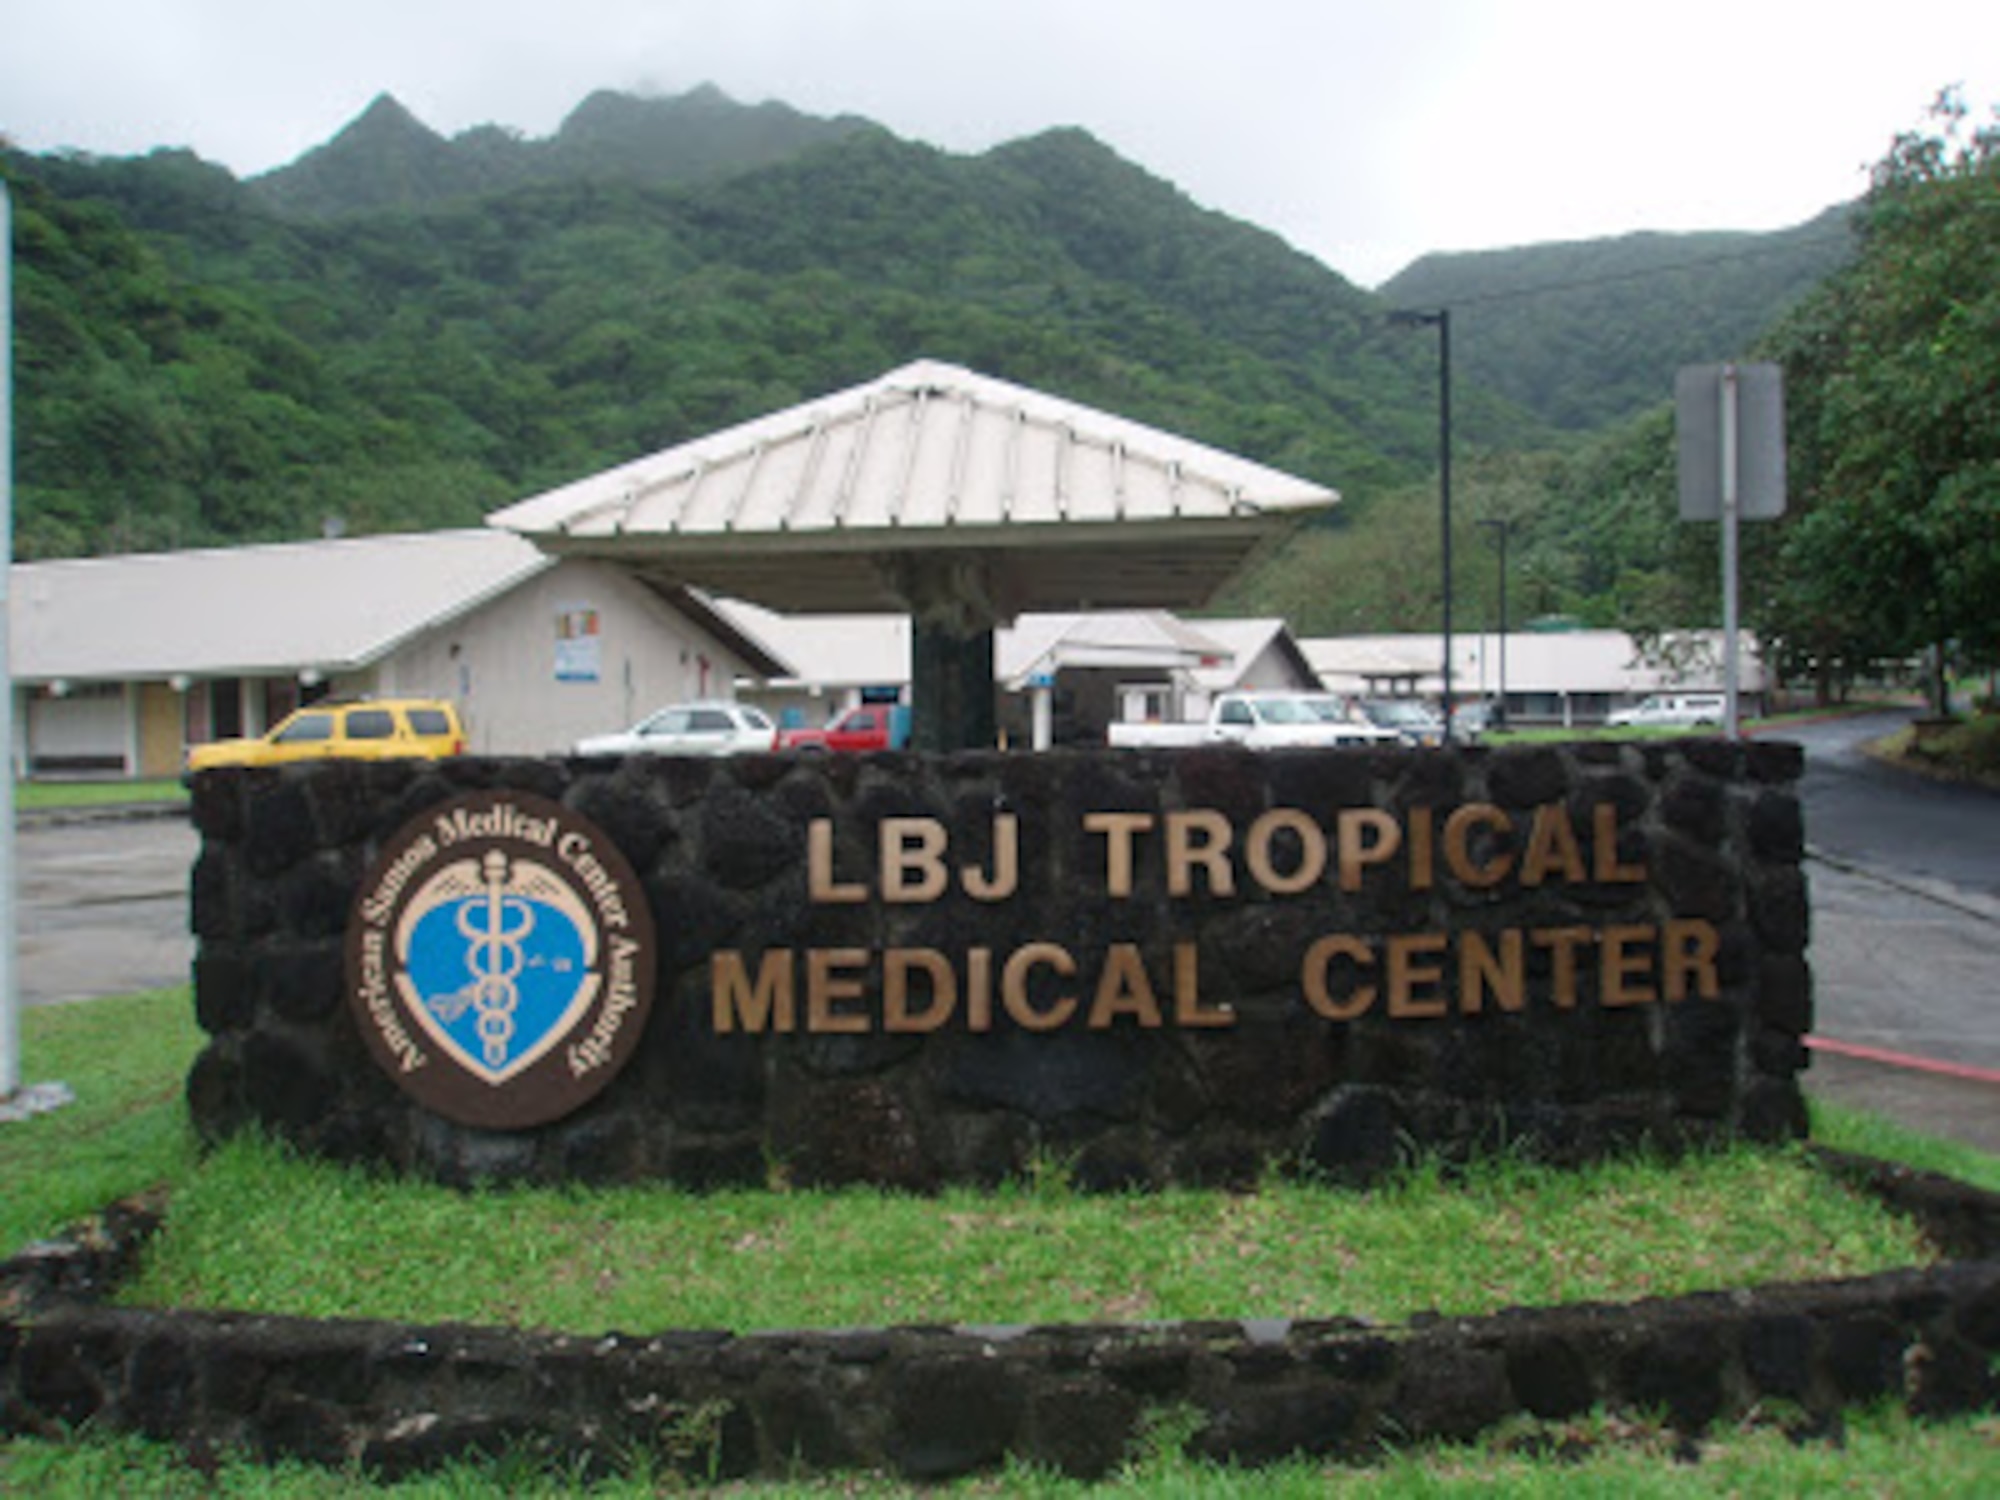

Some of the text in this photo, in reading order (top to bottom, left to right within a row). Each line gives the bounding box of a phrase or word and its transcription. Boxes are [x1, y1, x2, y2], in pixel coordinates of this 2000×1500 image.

[807, 802, 1648, 903] LBJ TROPICAL
[358, 804, 640, 1078] American Samoa Medical Center Authority
[710, 918, 1721, 1034] MEDICAL CENTER
